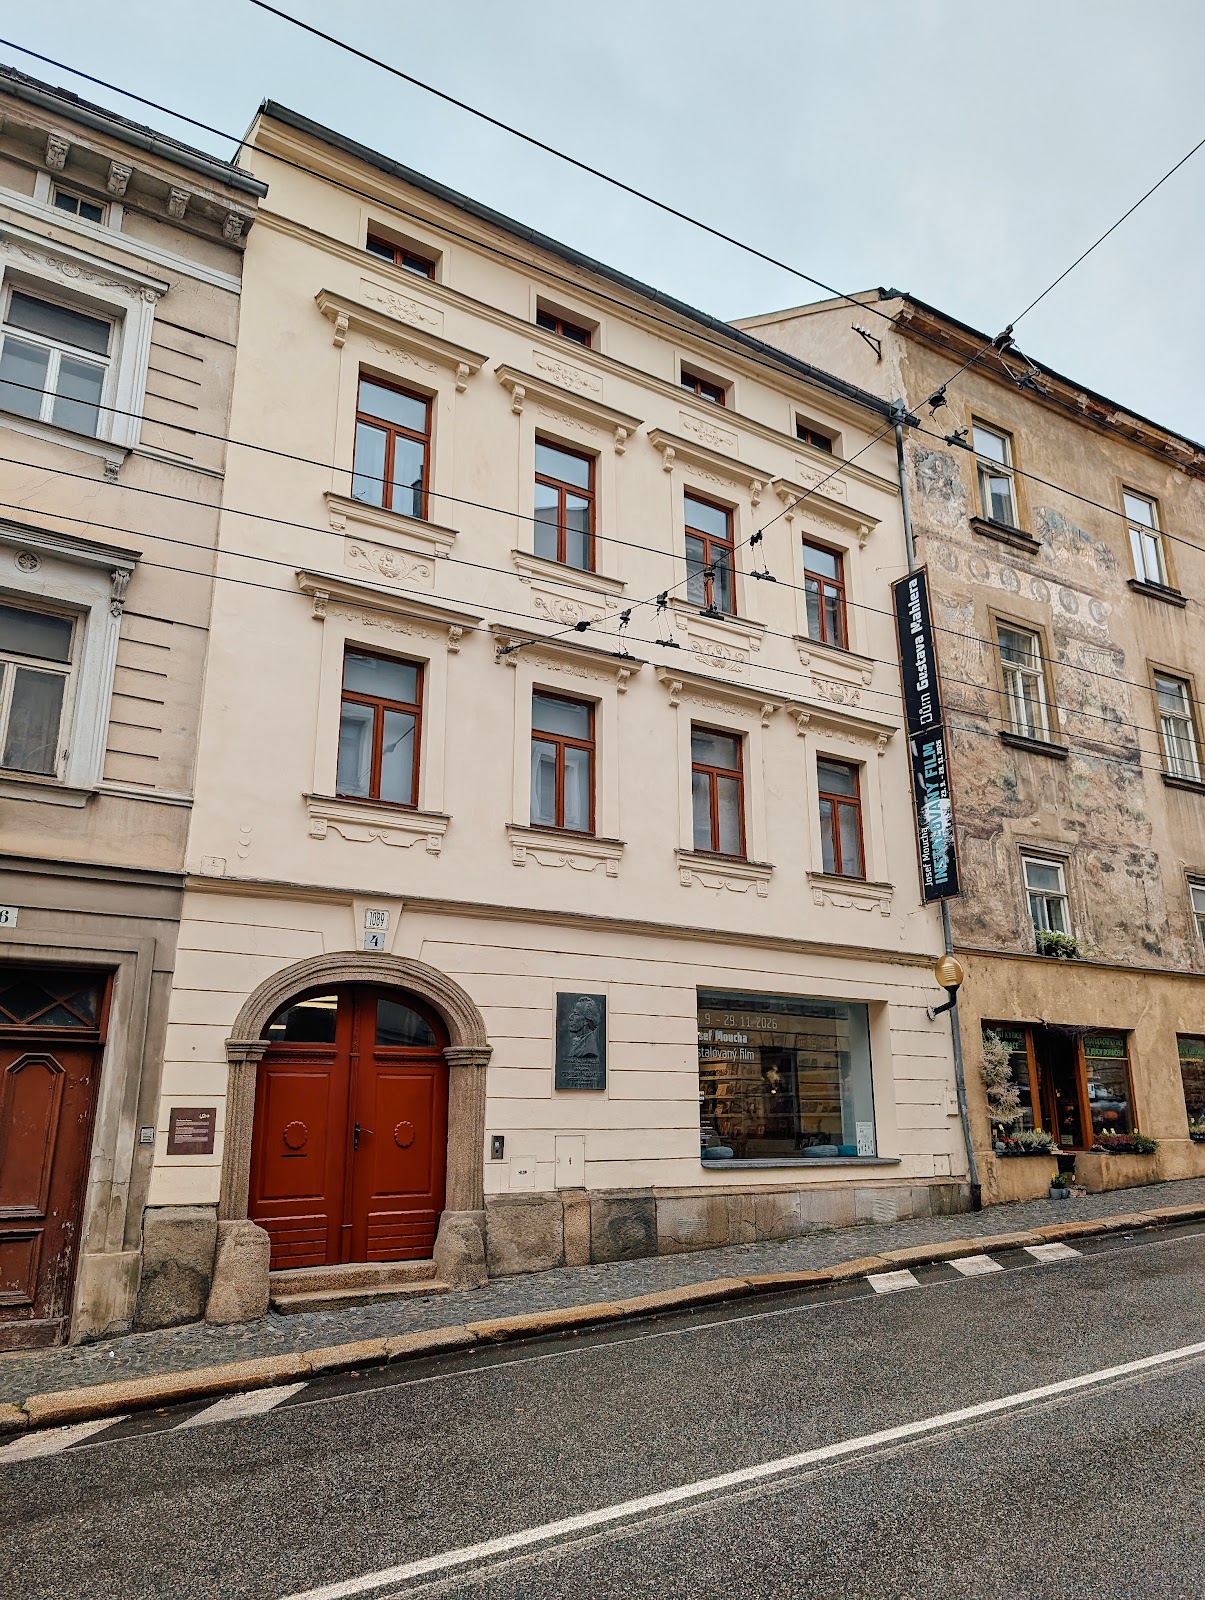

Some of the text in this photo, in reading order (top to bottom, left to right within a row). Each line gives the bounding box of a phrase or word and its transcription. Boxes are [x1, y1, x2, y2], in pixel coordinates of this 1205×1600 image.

[908, 577, 933, 725] Dům Gustava Mahlera
[923, 741, 938, 779] FILM
[920, 827, 933, 887] Josef Moucha
[369, 911, 385, 927] 1089
[370, 935, 379, 947] 4
[724, 1014, 738, 1027] 29.
[740, 1016, 753, 1028] 11.
[756, 1016, 778, 1029] 2026
[714, 1029, 748, 1044] Moucha
[739, 1048, 755, 1060] film
